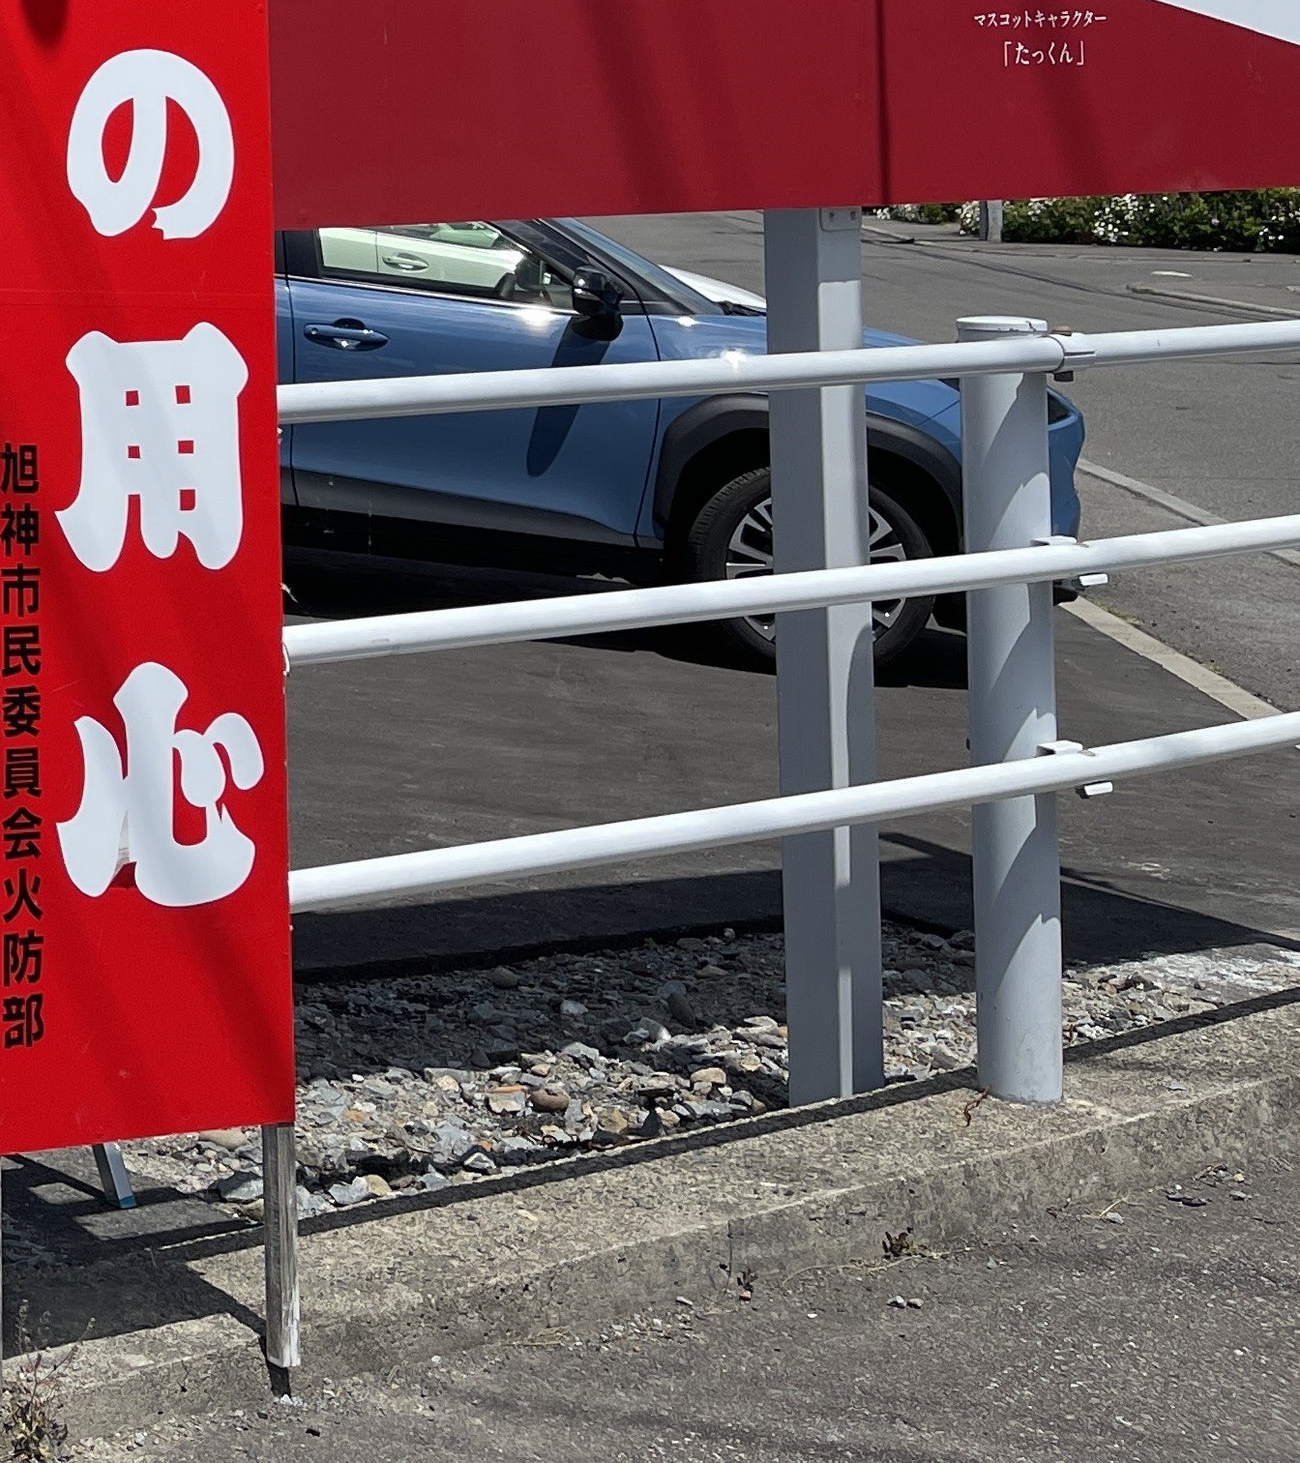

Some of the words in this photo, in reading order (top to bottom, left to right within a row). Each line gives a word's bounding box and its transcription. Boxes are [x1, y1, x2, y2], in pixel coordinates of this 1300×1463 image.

[974, 9, 1107, 29] マスコットキャラクター
[1003, 41, 1085, 67] 「たっくん」
[0, 443, 44, 1050] 旭神市民委員会火防部
